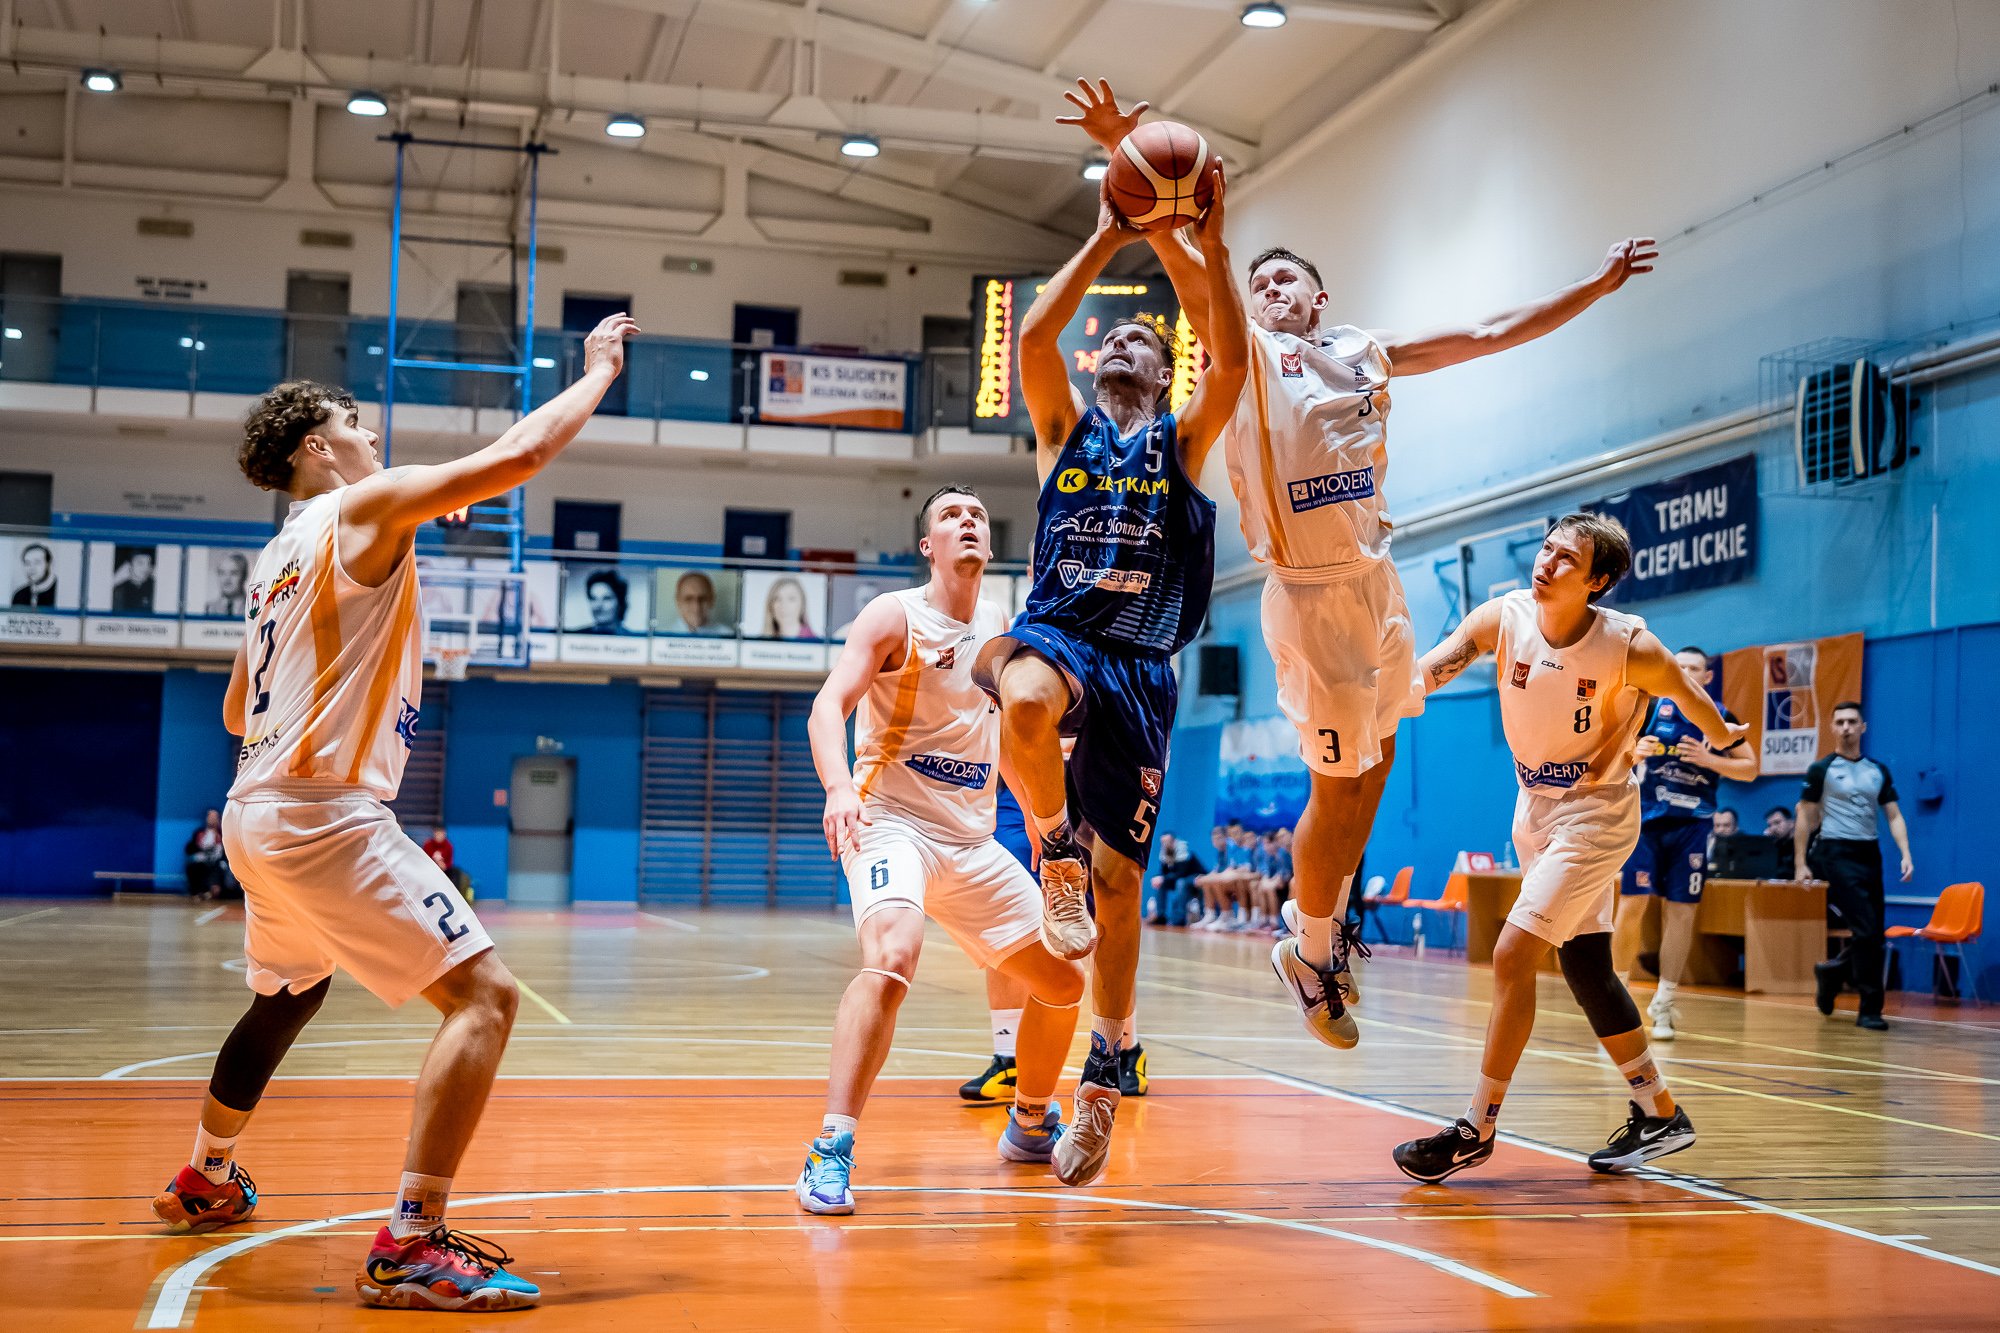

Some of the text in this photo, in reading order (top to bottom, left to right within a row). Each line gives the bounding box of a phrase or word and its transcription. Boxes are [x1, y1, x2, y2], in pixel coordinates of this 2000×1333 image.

[1144, 430, 1163, 473] 5
[1062, 473, 1081, 488] K
[1095, 475, 1169, 496] ZETKAM
[1310, 468, 1374, 497] MODERN
[1653, 483, 1729, 534] TERMY
[1081, 515, 1104, 533] La
[1633, 523, 1749, 581] CIEPLICKIE
[1541, 660, 1564, 671] COLO
[1573, 705, 1592, 734] 8
[1317, 728, 1342, 764] 3
[1764, 735, 1815, 755] SUDETY
[923, 756, 990, 781] MODERN
[1128, 798, 1157, 844] 5
[870, 858, 889, 890] 6
[1688, 871, 1703, 895] 8
[422, 891, 470, 943] 2
[400, 1213, 443, 1221] SUDETY
